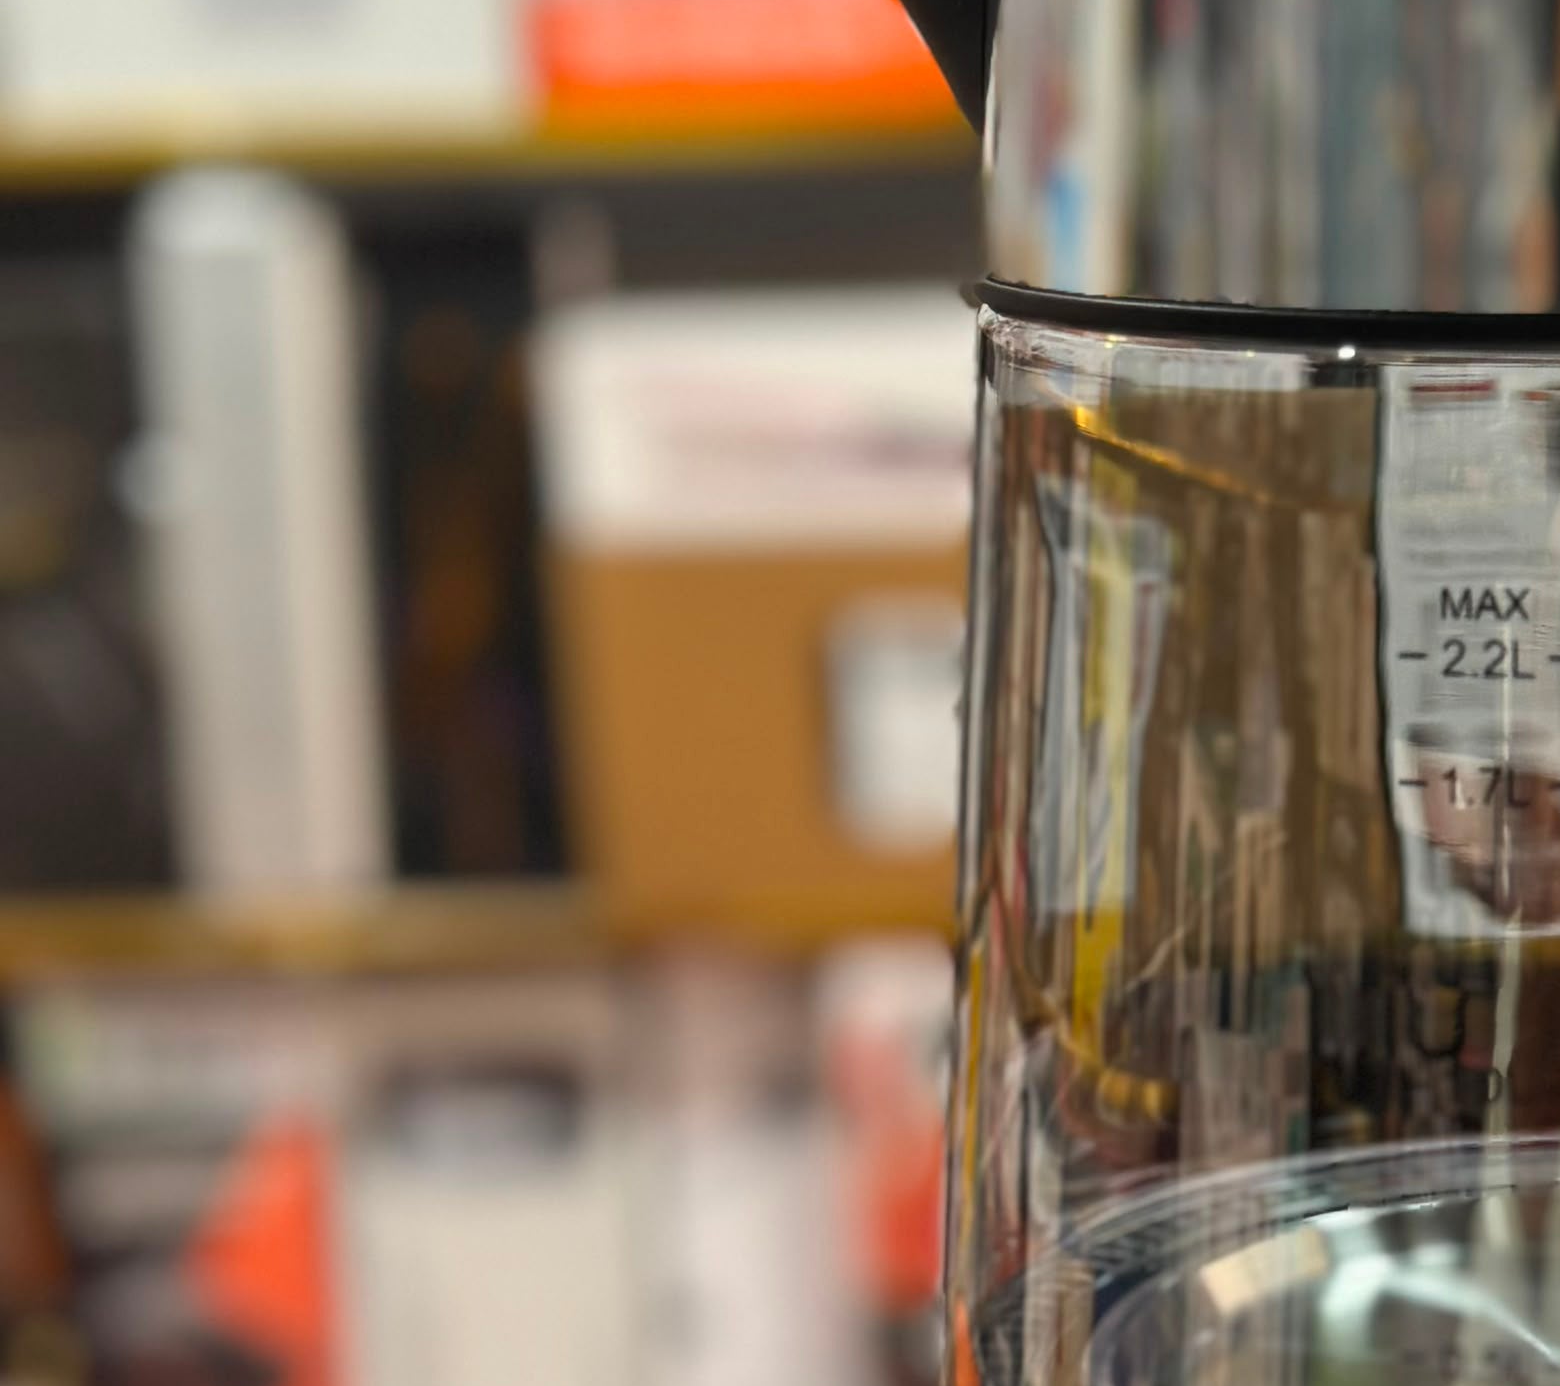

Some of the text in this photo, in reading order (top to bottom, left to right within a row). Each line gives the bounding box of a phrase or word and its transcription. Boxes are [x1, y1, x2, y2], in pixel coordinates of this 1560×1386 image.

[1440, 588, 1530, 622] MAX
[1441, 639, 1535, 680] 2.2L
[1445, 767, 1531, 809] 1.7L
